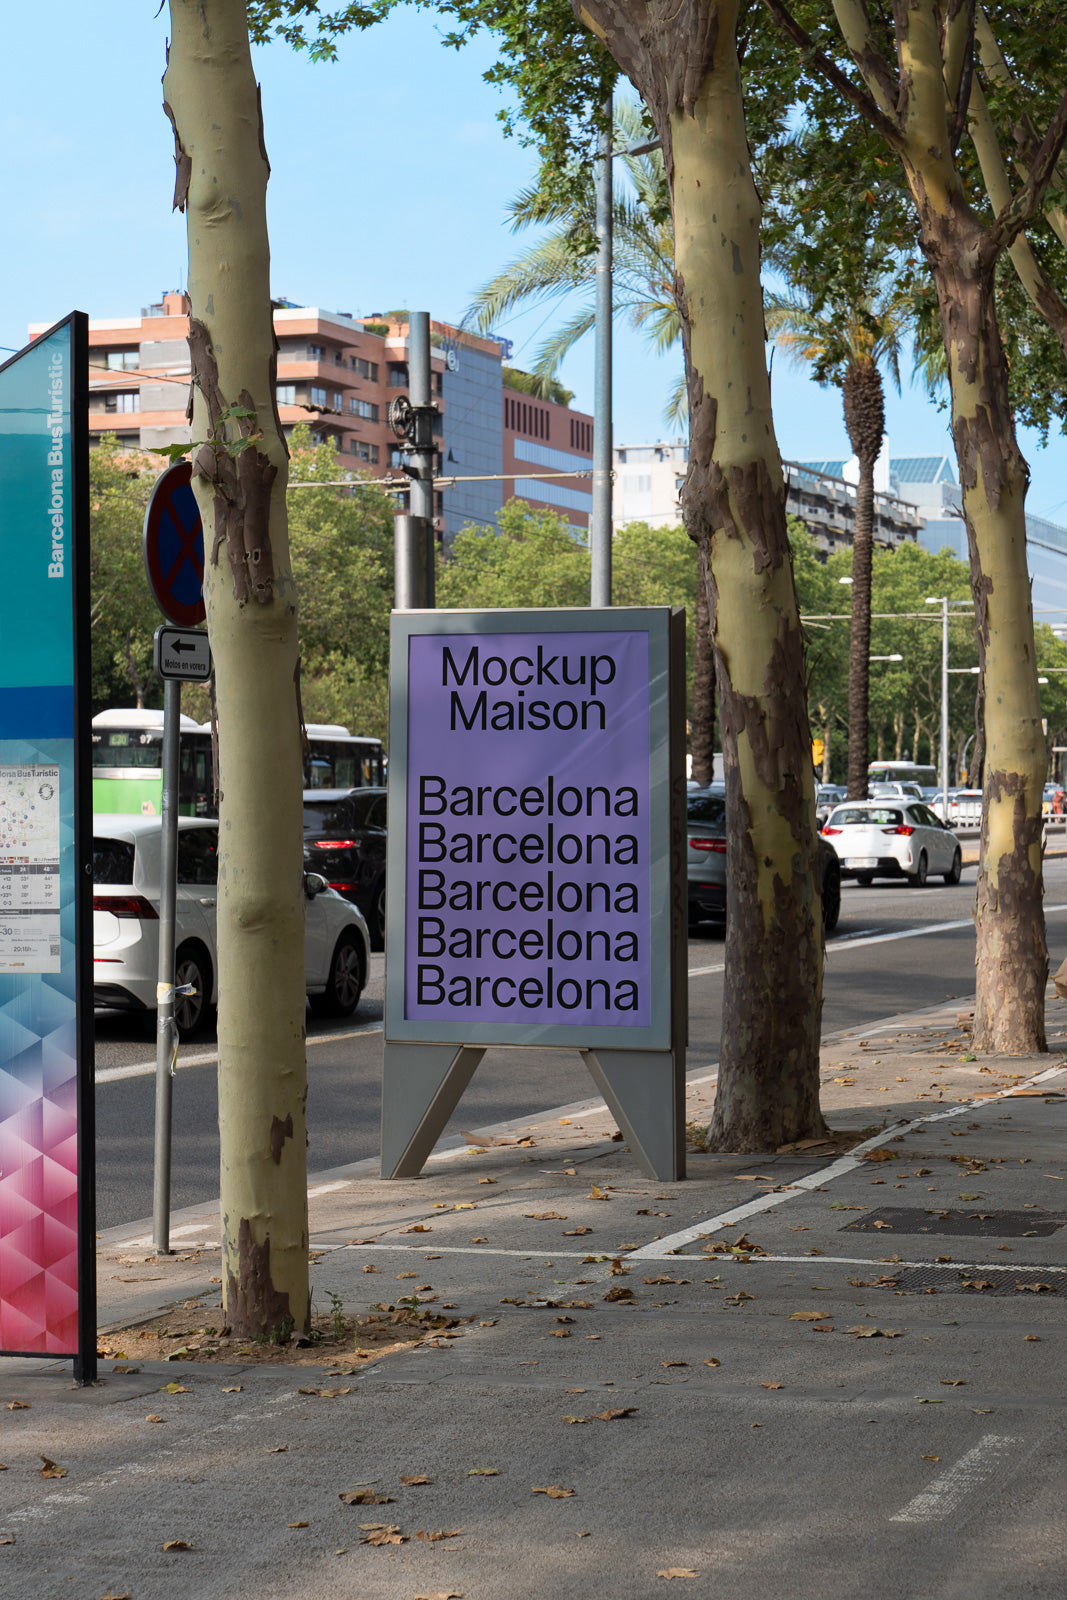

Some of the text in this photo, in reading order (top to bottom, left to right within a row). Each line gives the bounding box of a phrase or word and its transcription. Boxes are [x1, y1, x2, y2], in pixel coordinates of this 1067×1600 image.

[47, 468, 64, 578] Barcelona
[164, 659, 180, 669] Motos
[190, 663, 206, 671] vorera
[442, 645, 617, 696] Mockup
[450, 690, 606, 731] Maison
[419, 775, 639, 817] Barcelona
[418, 822, 639, 866] Barcelona
[417, 869, 639, 914] Barcelona
[417, 916, 639, 962] Barcelona
[416, 963, 639, 1011] Barcelona
